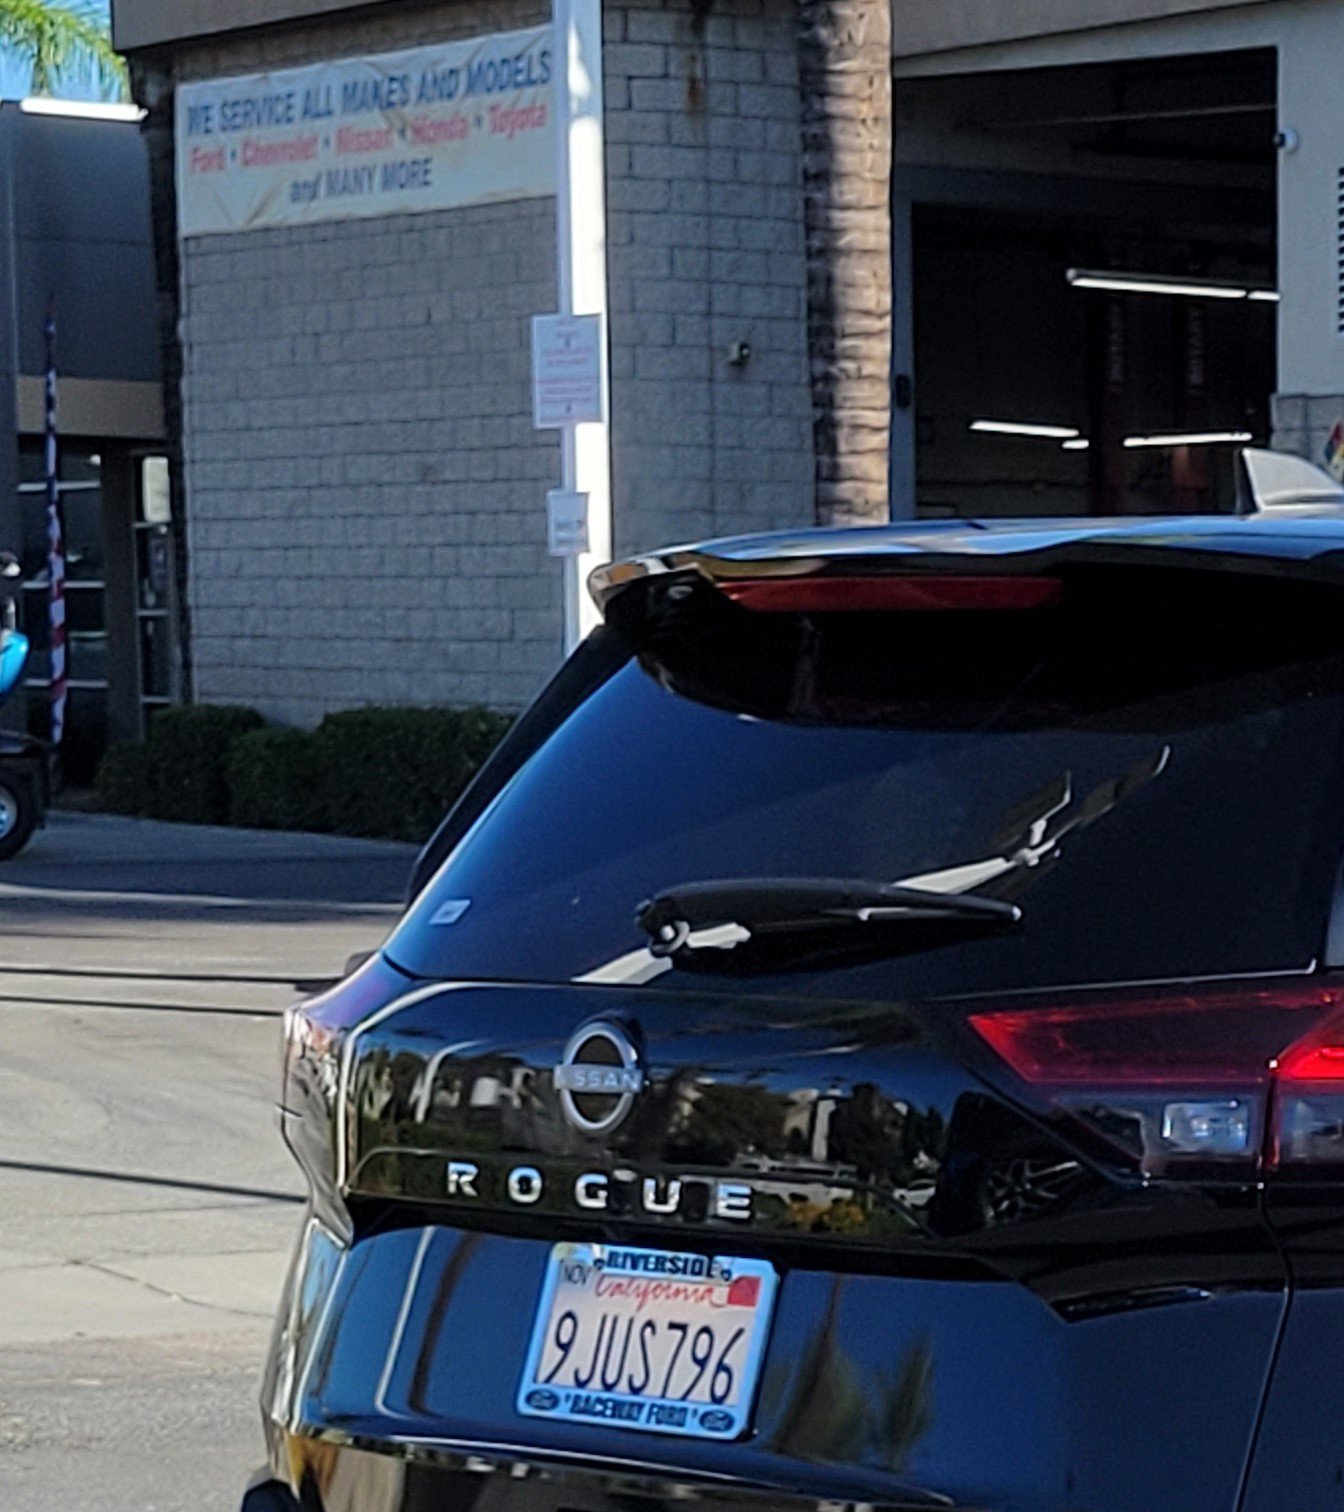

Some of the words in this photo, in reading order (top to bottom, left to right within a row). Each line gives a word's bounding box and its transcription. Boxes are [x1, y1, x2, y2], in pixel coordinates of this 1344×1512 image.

[187, 104, 212, 136] WE
[220, 93, 295, 132] SERVICE
[303, 84, 332, 120] ALL
[340, 72, 410, 113] MAKES
[417, 66, 460, 103] AND
[467, 50, 552, 96] MODELS
[190, 147, 226, 172] Ford
[490, 99, 546, 140] Toyota
[324, 164, 376, 198] MANY
[381, 158, 433, 191] MORE
[448, 1162, 751, 1218] ROGUE
[594, 1272, 727, 1312] California
[605, 1250, 720, 1279] RIVERSIDE
[542, 1309, 747, 1405] 9JUS796
